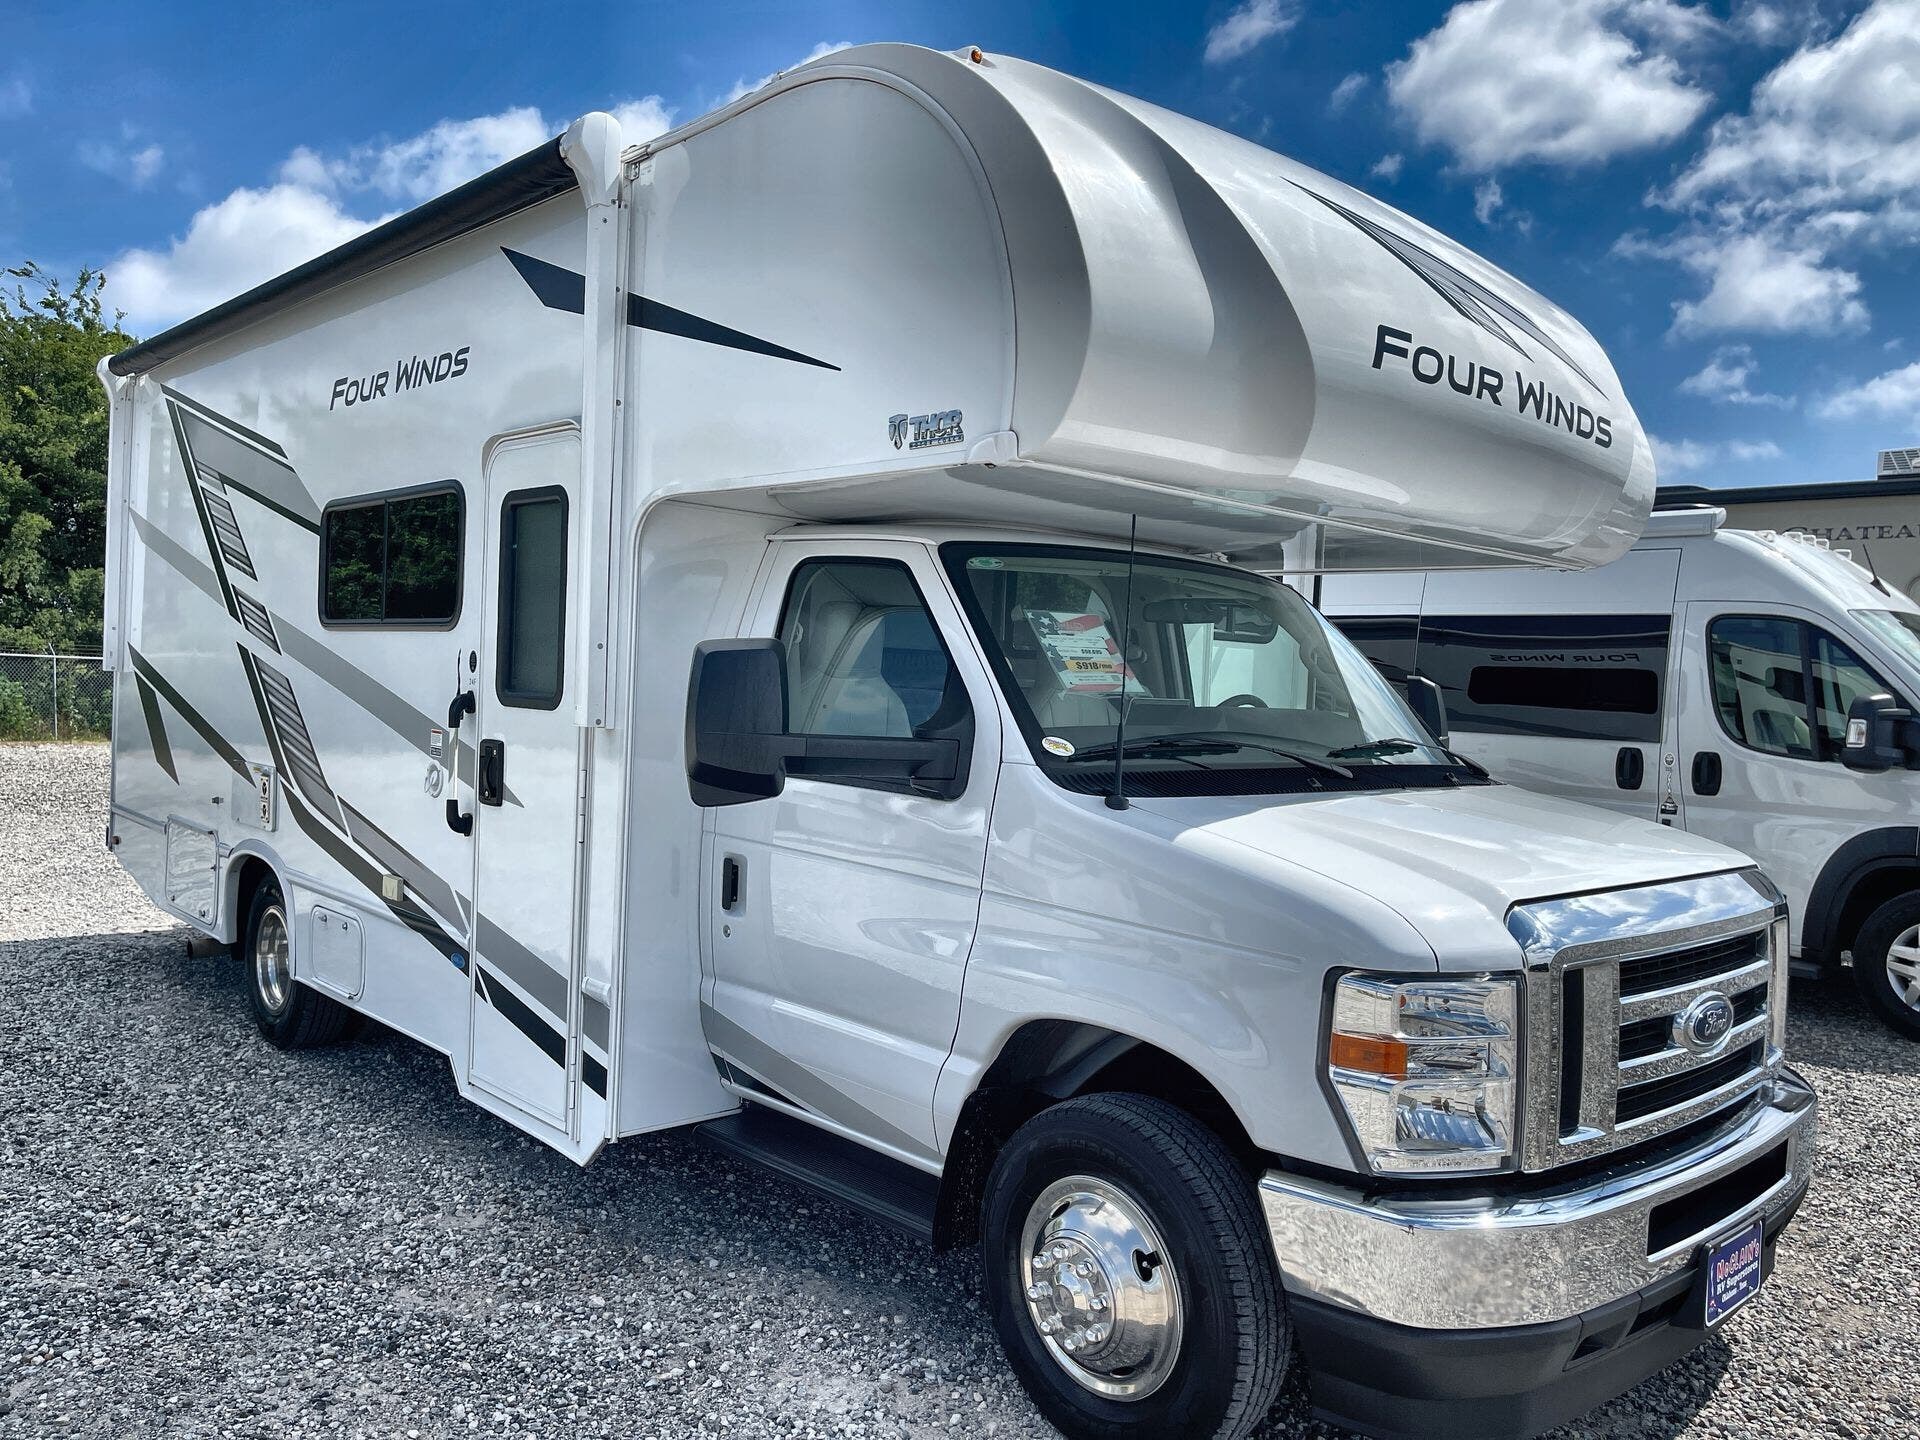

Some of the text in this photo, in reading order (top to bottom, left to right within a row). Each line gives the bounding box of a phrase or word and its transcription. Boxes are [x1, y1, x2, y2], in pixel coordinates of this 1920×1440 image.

[329, 346, 471, 411] FOUR WINDS
[1371, 323, 1613, 449] FOUR WINDS
[909, 409, 963, 441] THOR
[1782, 524, 1920, 541] HATEA
